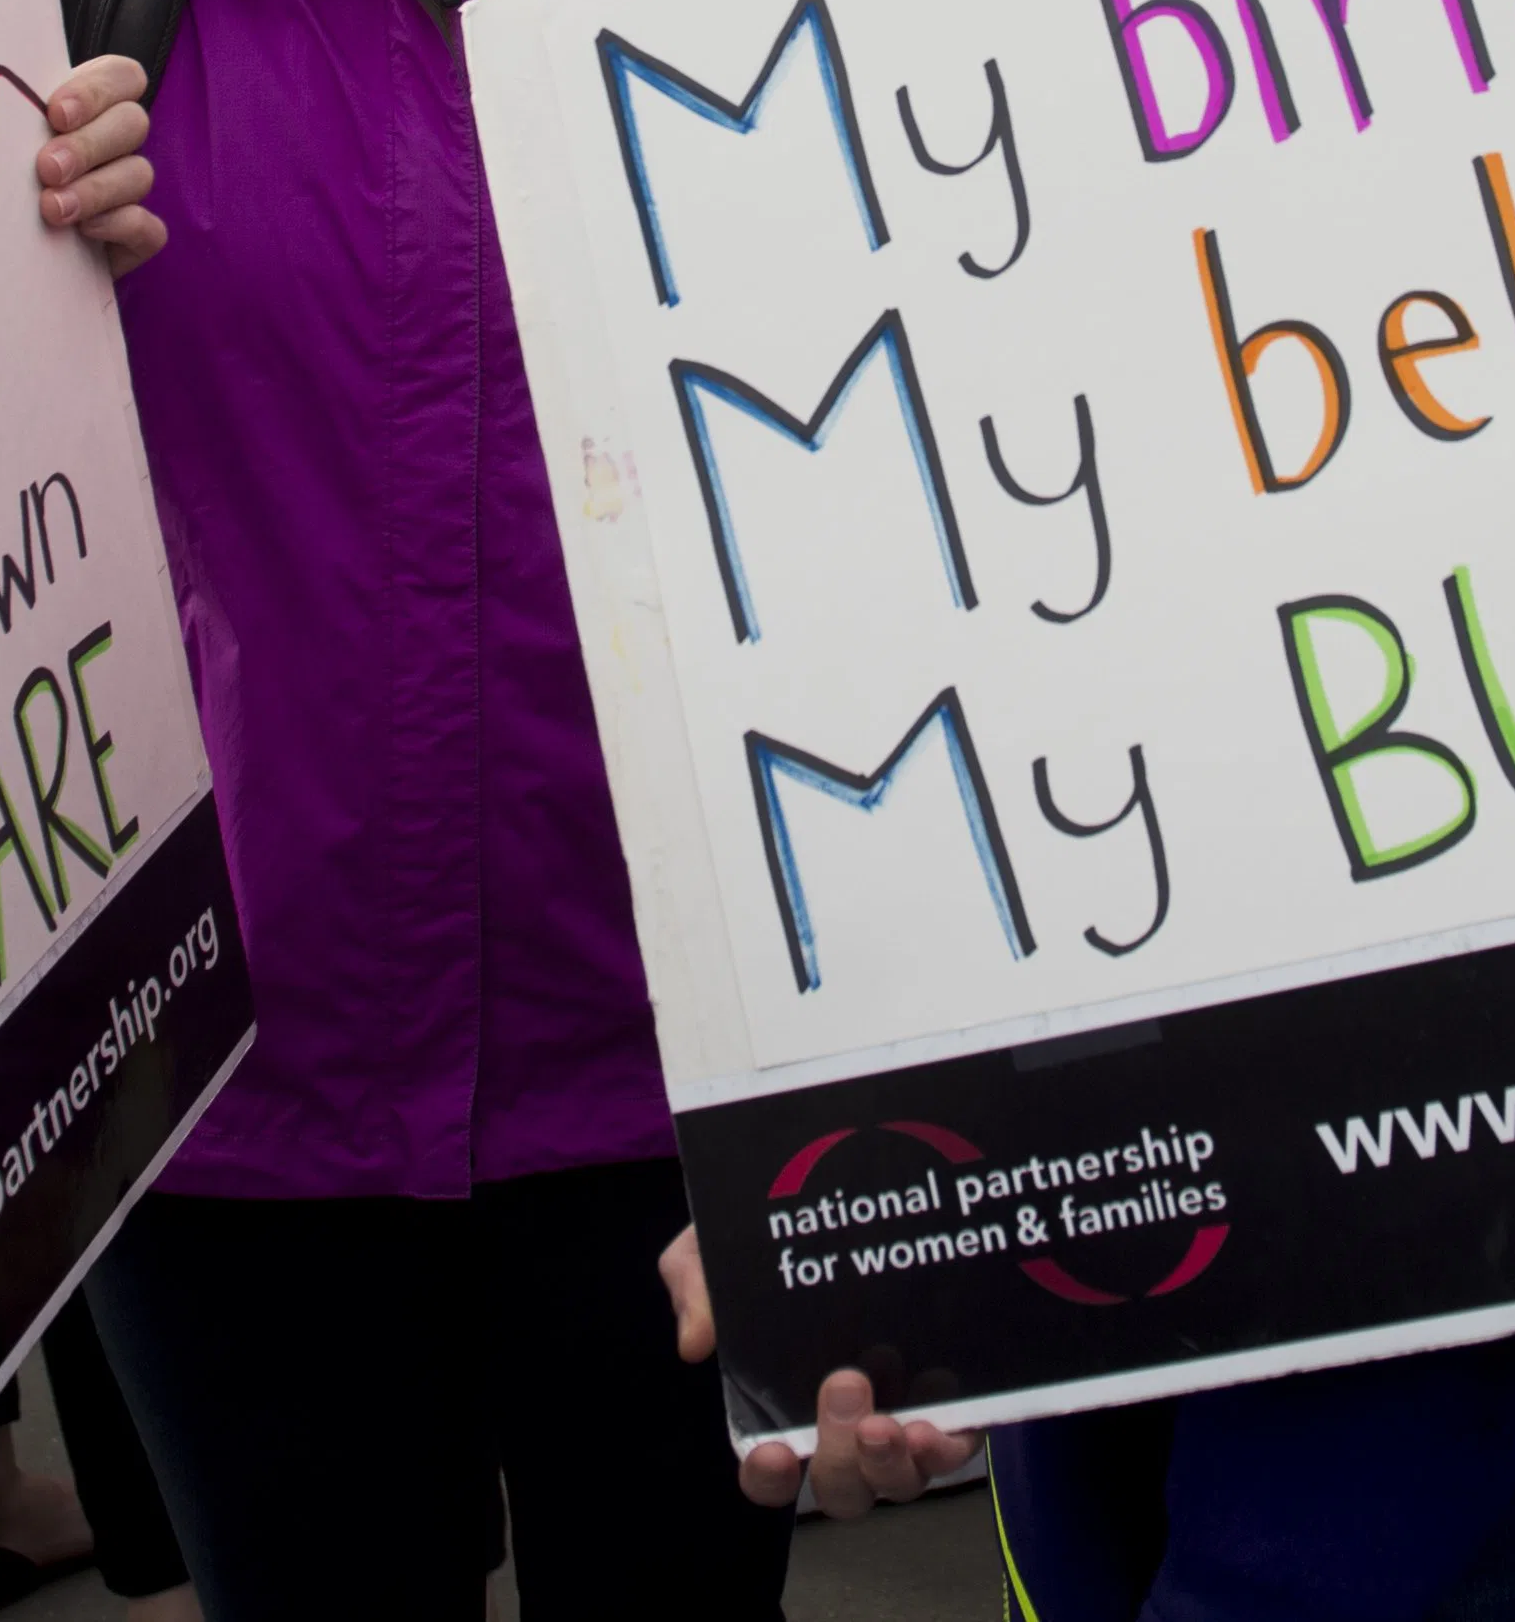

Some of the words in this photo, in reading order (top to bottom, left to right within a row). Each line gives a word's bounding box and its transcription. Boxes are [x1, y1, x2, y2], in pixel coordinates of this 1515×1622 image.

[668, 307, 1111, 645] My
[743, 685, 1171, 995] My
[768, 1170, 941, 1241] national
[956, 1124, 1215, 1216] partnership
[777, 1249, 838, 1289] for
[851, 1223, 1007, 1278] women
[1016, 1208, 1050, 1247] &
[1059, 1181, 1227, 1239] families
